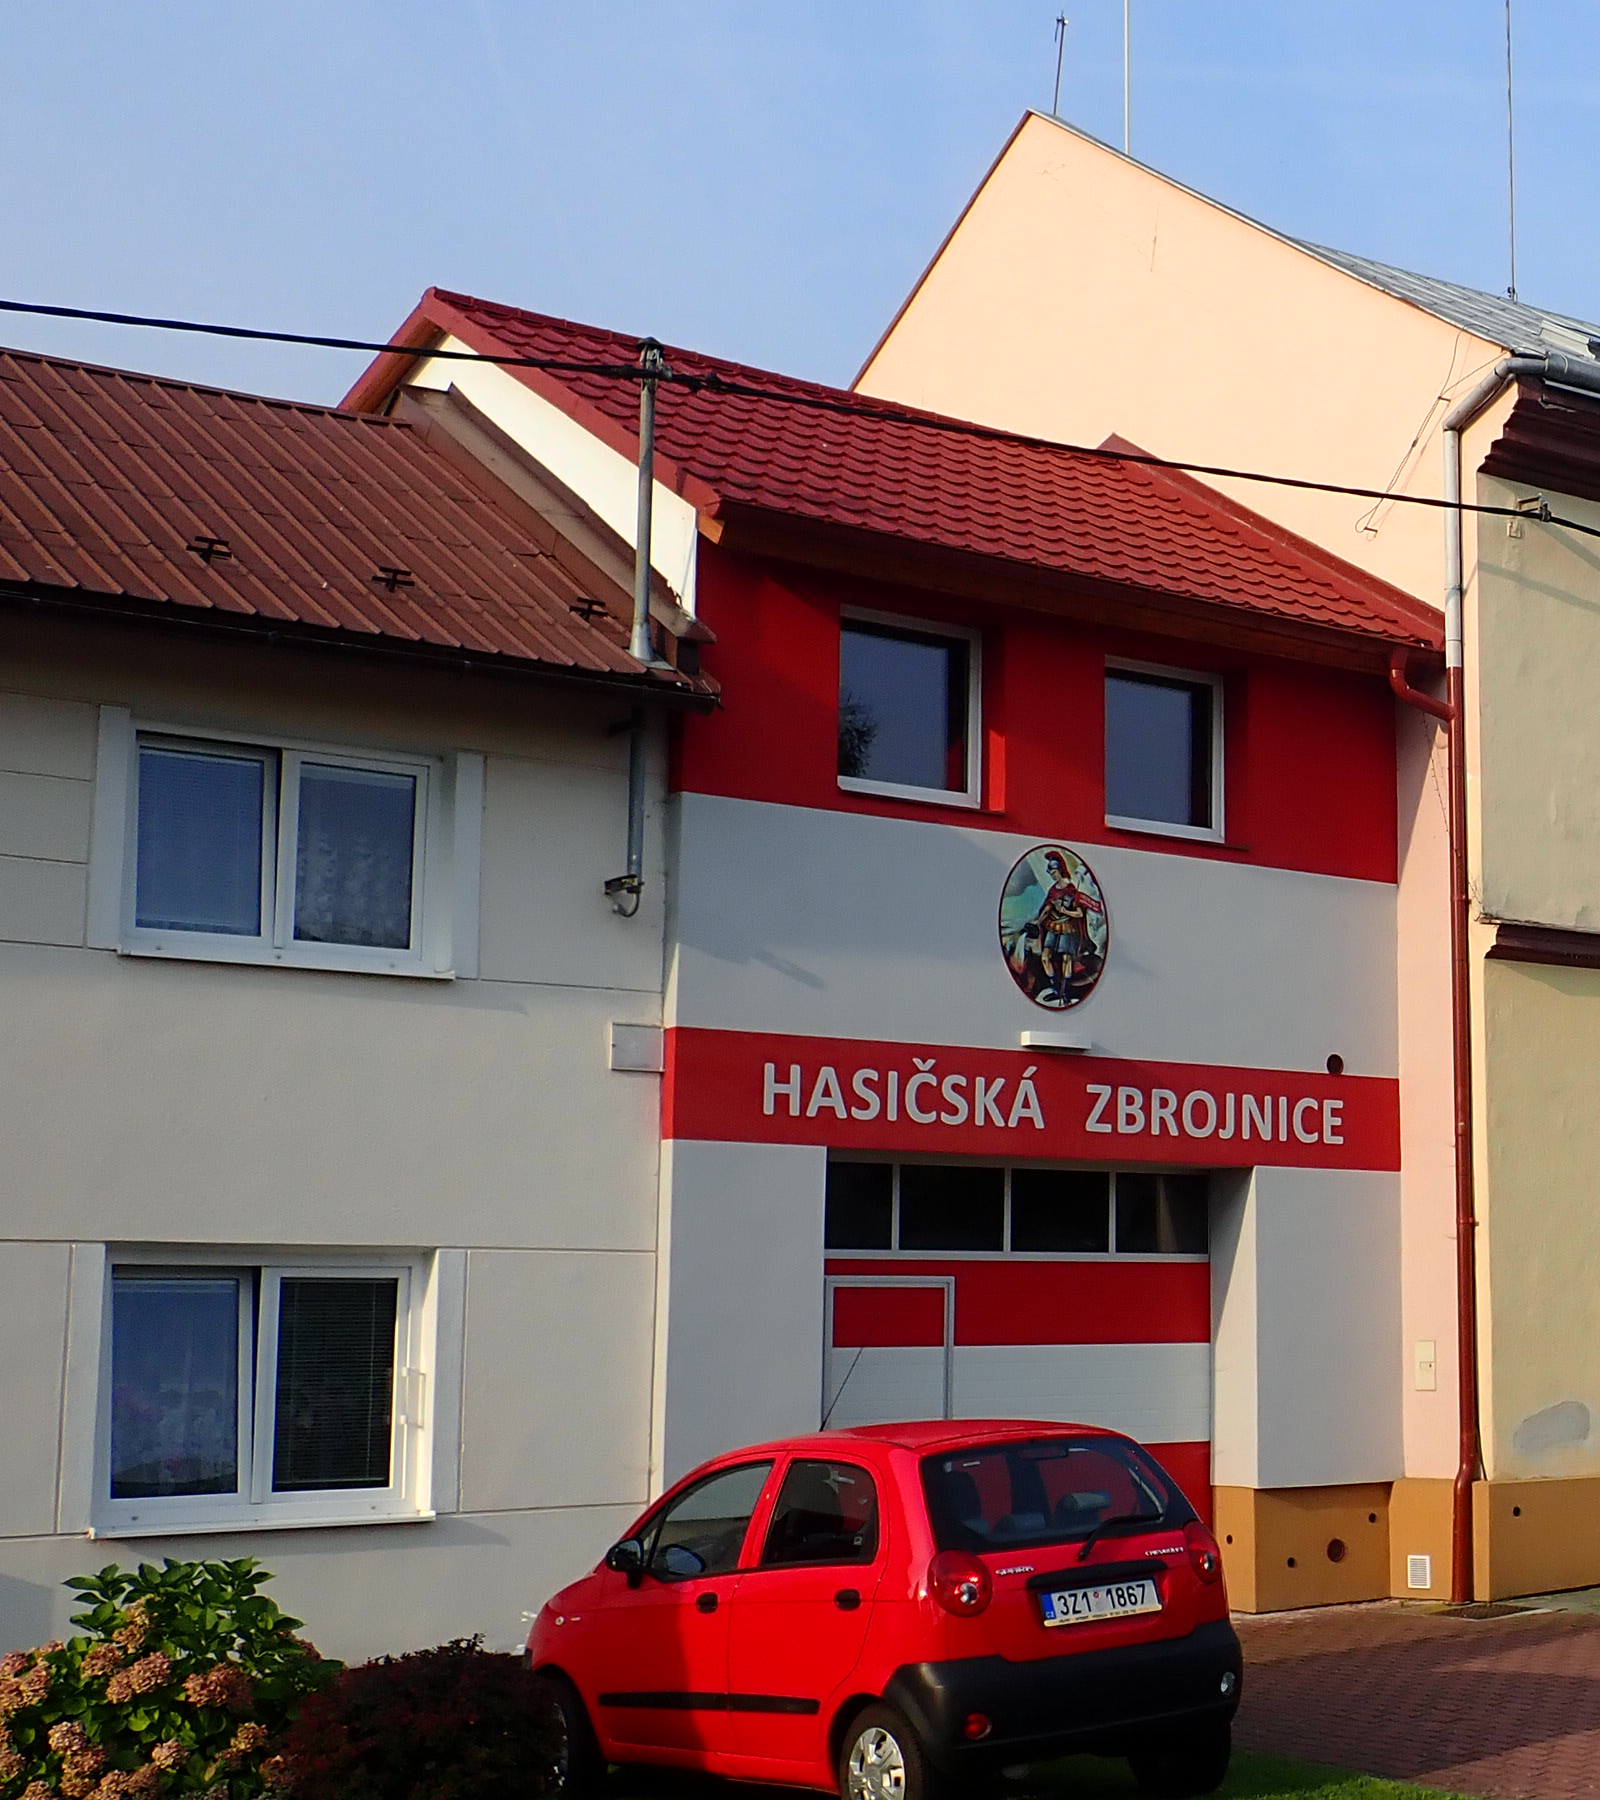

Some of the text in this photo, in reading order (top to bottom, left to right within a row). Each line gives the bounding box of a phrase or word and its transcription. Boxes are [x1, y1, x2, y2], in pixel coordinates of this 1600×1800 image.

[763, 1057, 1344, 1144] HASIČSKÁ ZBROJNICE
[1057, 1591, 1092, 1616] 3Z1
[1105, 1583, 1146, 1609] 1867
